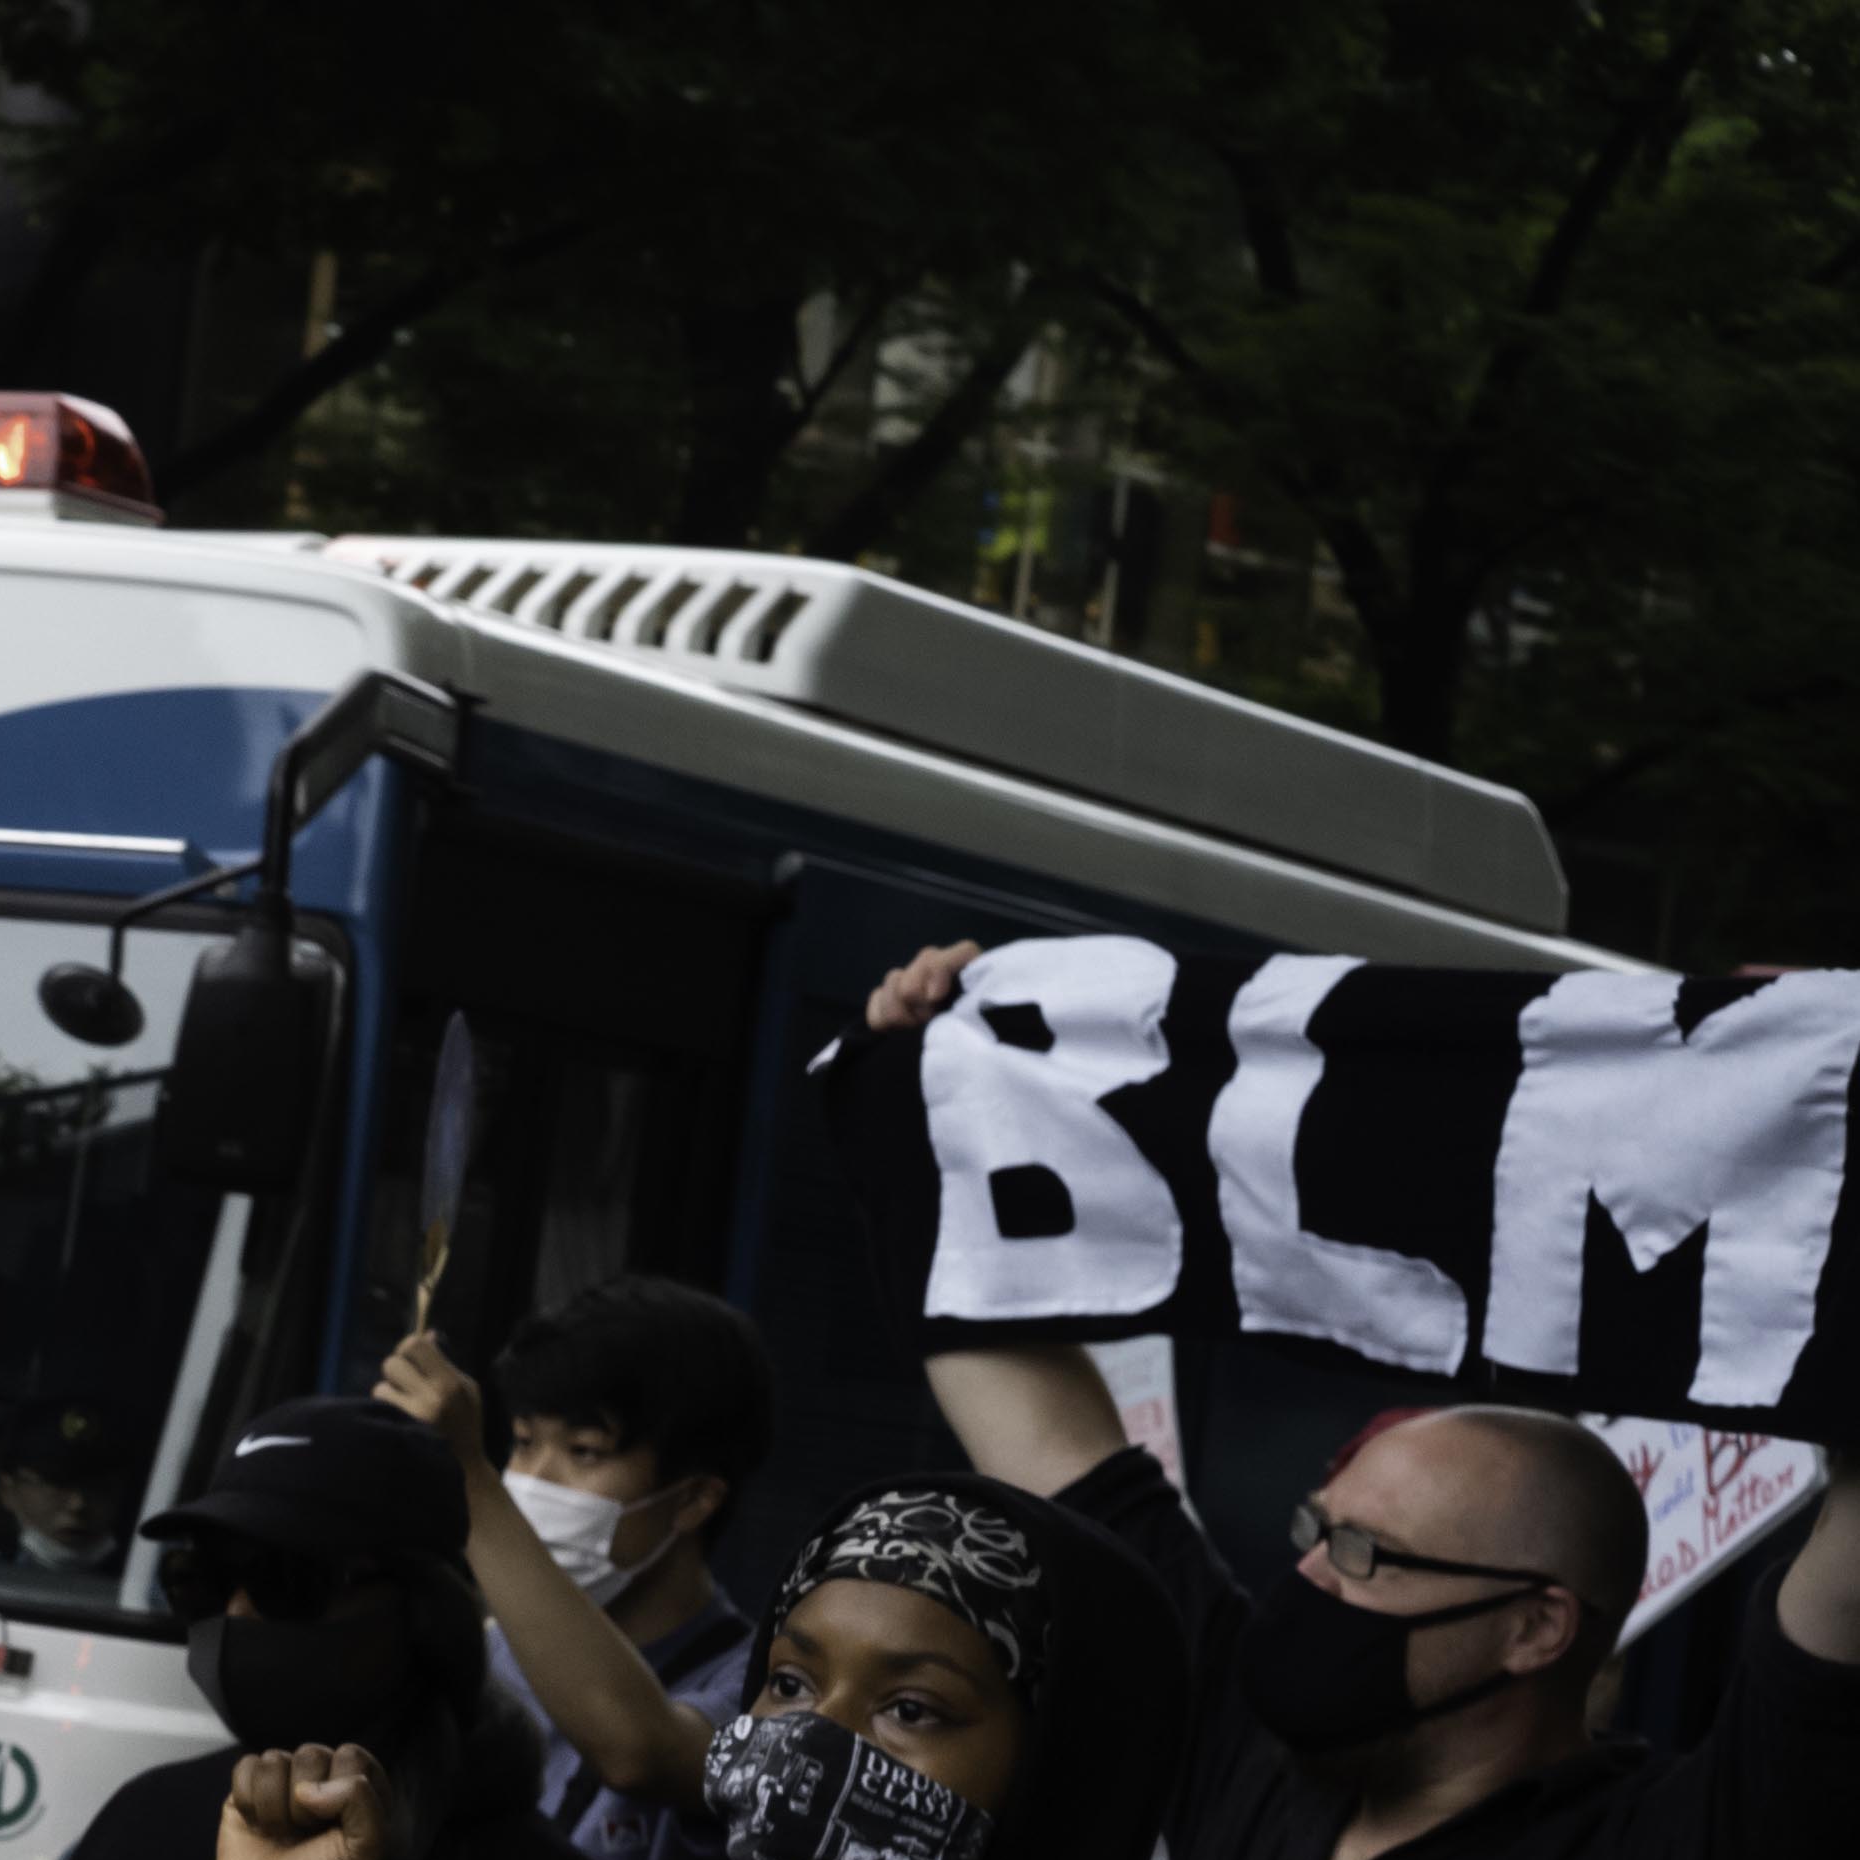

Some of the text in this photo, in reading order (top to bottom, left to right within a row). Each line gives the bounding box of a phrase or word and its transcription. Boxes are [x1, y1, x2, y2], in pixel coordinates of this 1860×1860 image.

[920, 933, 1860, 1407] BLM
[860, 1771, 950, 1823] CLASS
[866, 1750, 954, 1810] DRUM
